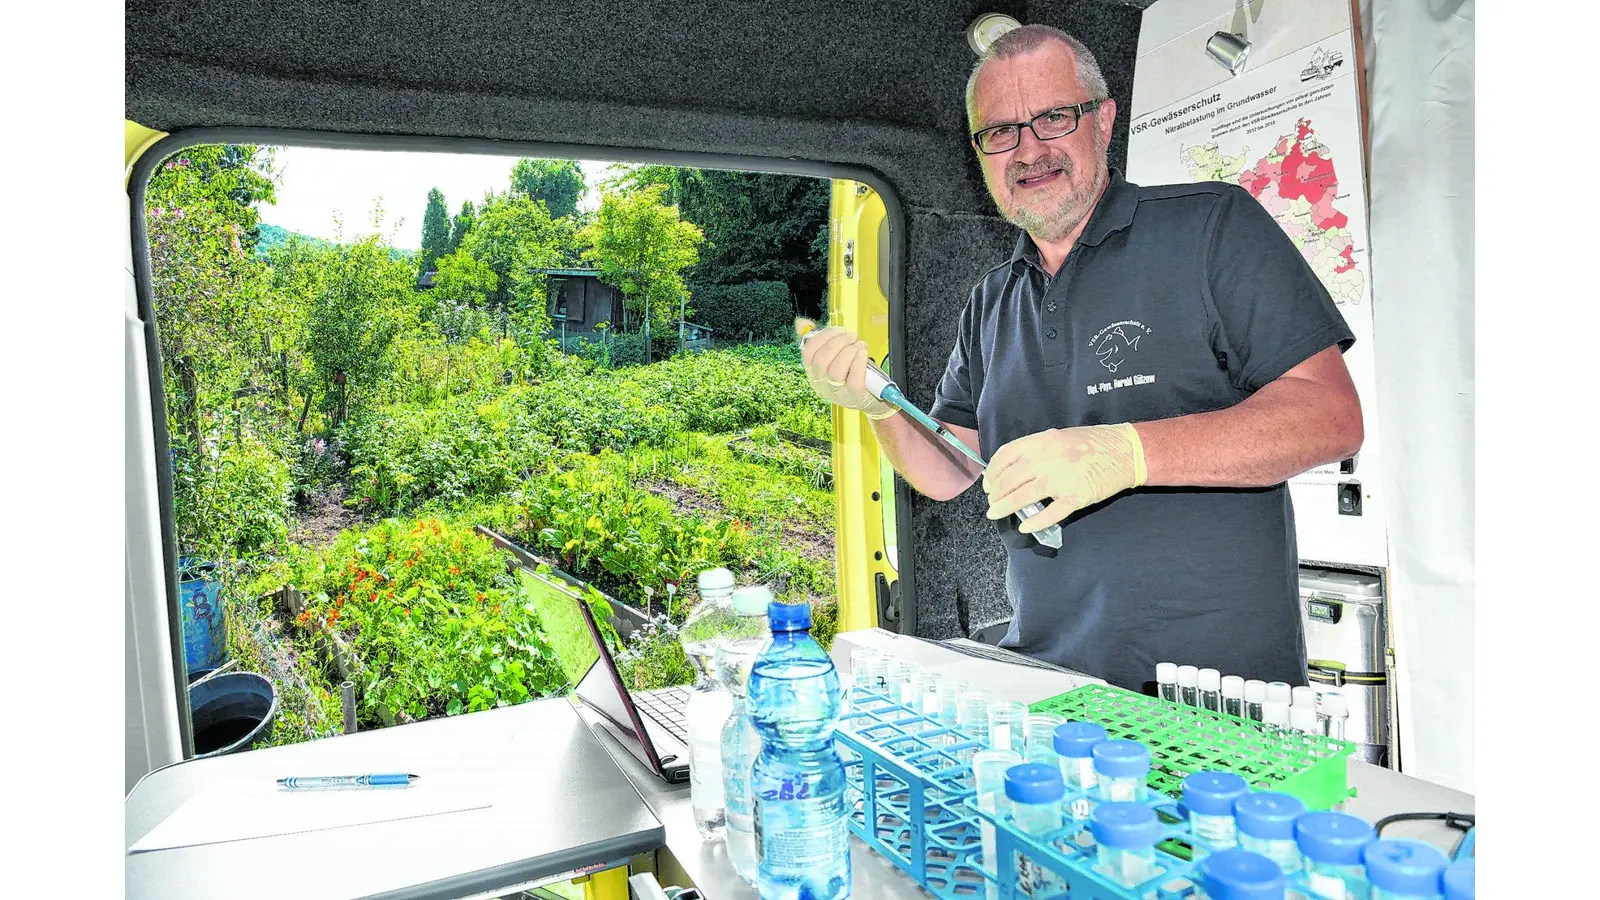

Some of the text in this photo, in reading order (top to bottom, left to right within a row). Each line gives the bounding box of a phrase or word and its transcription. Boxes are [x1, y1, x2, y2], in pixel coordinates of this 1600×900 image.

[1130, 93, 1221, 135] VSR-Gewässerschutz
[1165, 85, 1277, 135] Nitratbelastung im Grundwasser
[1211, 121, 1231, 133] Grundlage
[1249, 102, 1285, 119] Untersuchungen
[1294, 93, 1308, 102] privat
[1309, 84, 1334, 97] genutzten
[1211, 129, 1229, 139] Brunnen
[1229, 125, 1241, 133] durch
[1250, 104, 1297, 124] VSR-Gewässerschutz
[1314, 92, 1332, 101] Jahren
